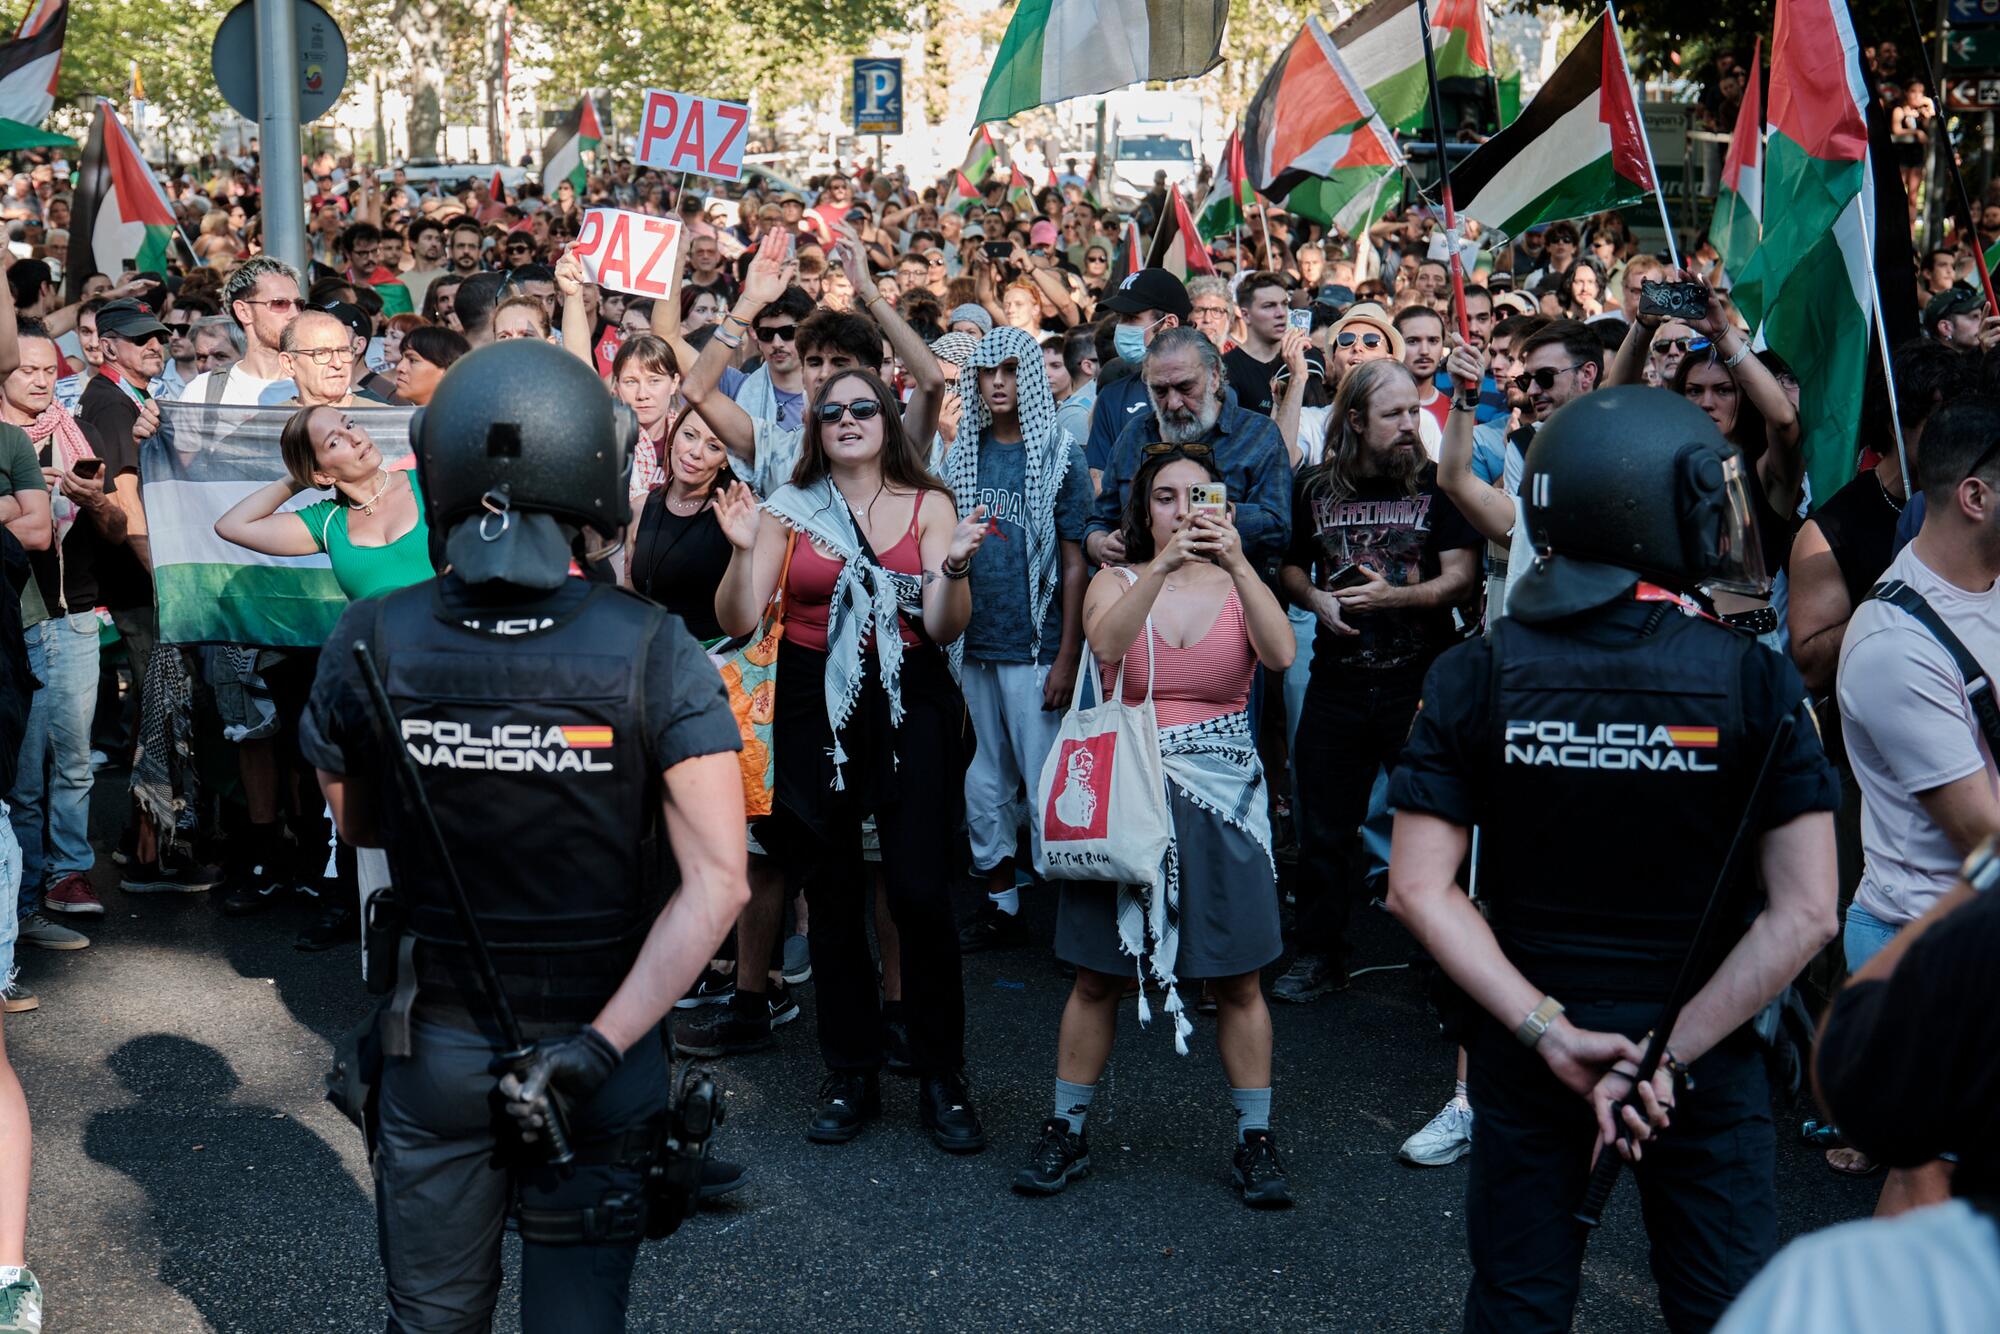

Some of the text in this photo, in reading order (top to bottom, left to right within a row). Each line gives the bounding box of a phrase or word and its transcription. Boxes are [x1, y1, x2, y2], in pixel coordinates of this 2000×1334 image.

[859, 69, 896, 114] P
[640, 92, 748, 178] PAZ
[572, 211, 676, 295] PAZ
[975, 488, 1027, 529] RDA
[1505, 720, 1674, 746] POLICIA
[406, 742, 613, 772] NACIONAL
[1504, 743, 1718, 771] NACIONAL
[1064, 852, 1084, 865] THE
[1085, 851, 1111, 865] RICH
